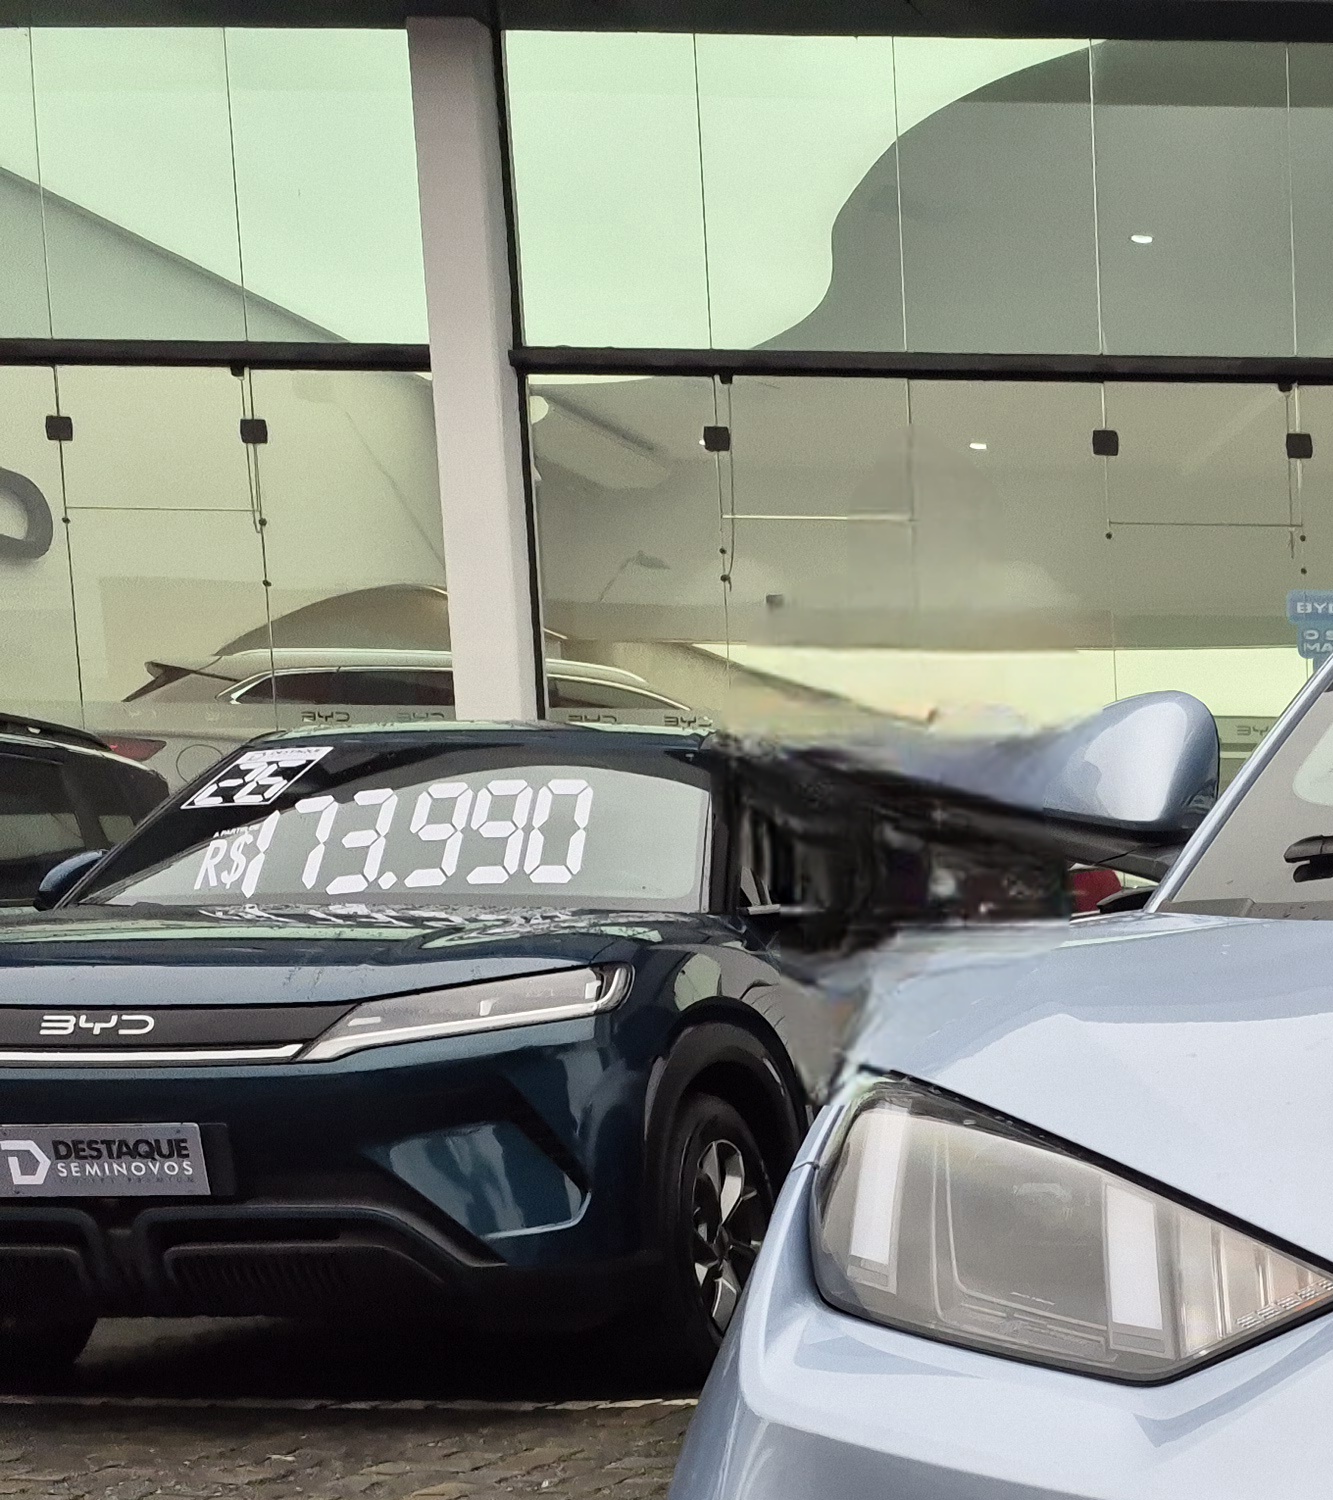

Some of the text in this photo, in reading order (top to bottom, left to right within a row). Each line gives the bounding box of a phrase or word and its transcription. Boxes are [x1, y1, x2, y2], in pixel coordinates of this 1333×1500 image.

[1236, 725, 1270, 736] BY
[39, 1014, 155, 1035] BYD
[52, 1138, 190, 1161] DESTAQUE
[57, 1161, 193, 1177] SEMINOVOS
